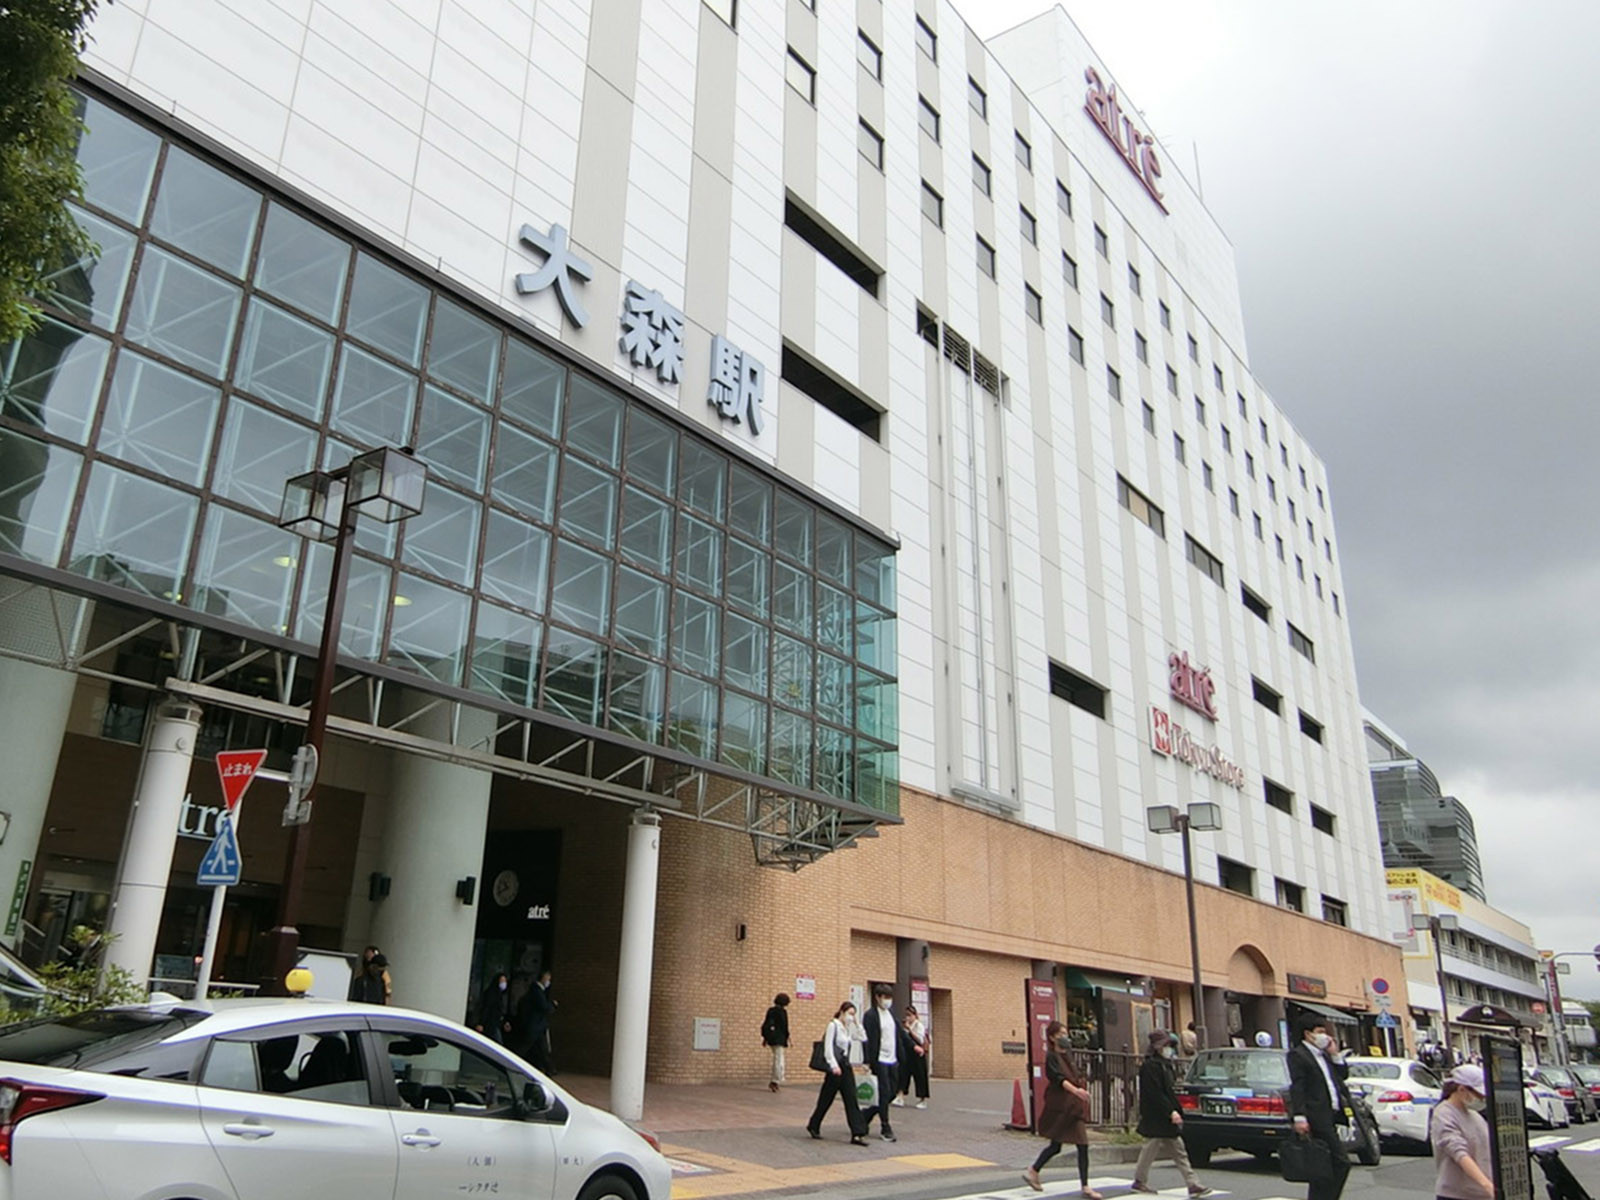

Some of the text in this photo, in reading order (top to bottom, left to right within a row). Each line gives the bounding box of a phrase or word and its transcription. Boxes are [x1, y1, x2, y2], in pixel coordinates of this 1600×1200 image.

[515, 223, 765, 436] 大森駅
[223, 763, 254, 777] 止まれ
[527, 904, 550, 919] atré
